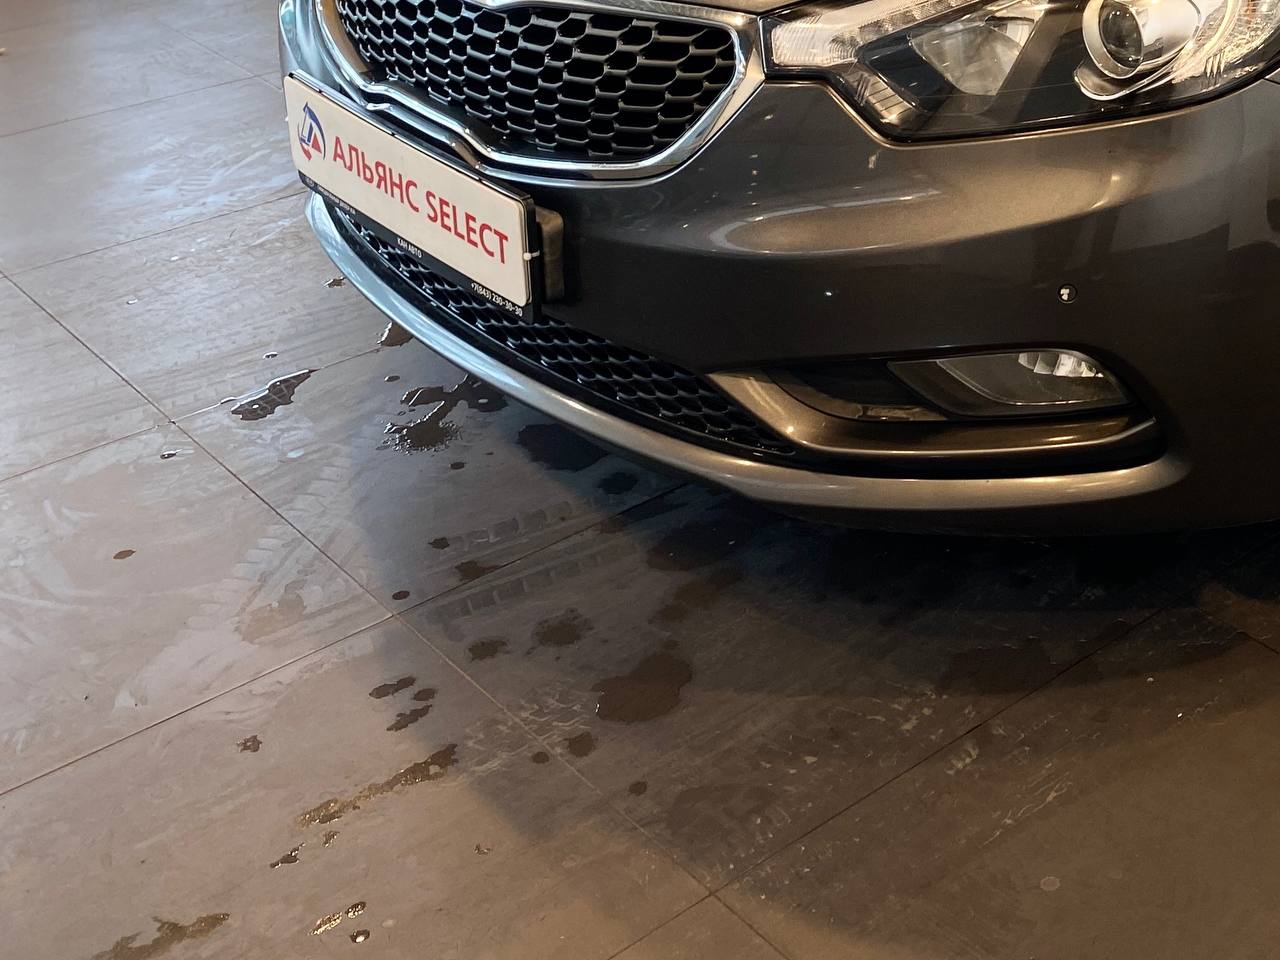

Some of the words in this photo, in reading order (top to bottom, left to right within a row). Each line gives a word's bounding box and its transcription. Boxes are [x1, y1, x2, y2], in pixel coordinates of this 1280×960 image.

[333, 136, 419, 213] АЛЬЯНС
[425, 191, 509, 264] SELECT
[492, 293, 523, 317] 230-30-30
